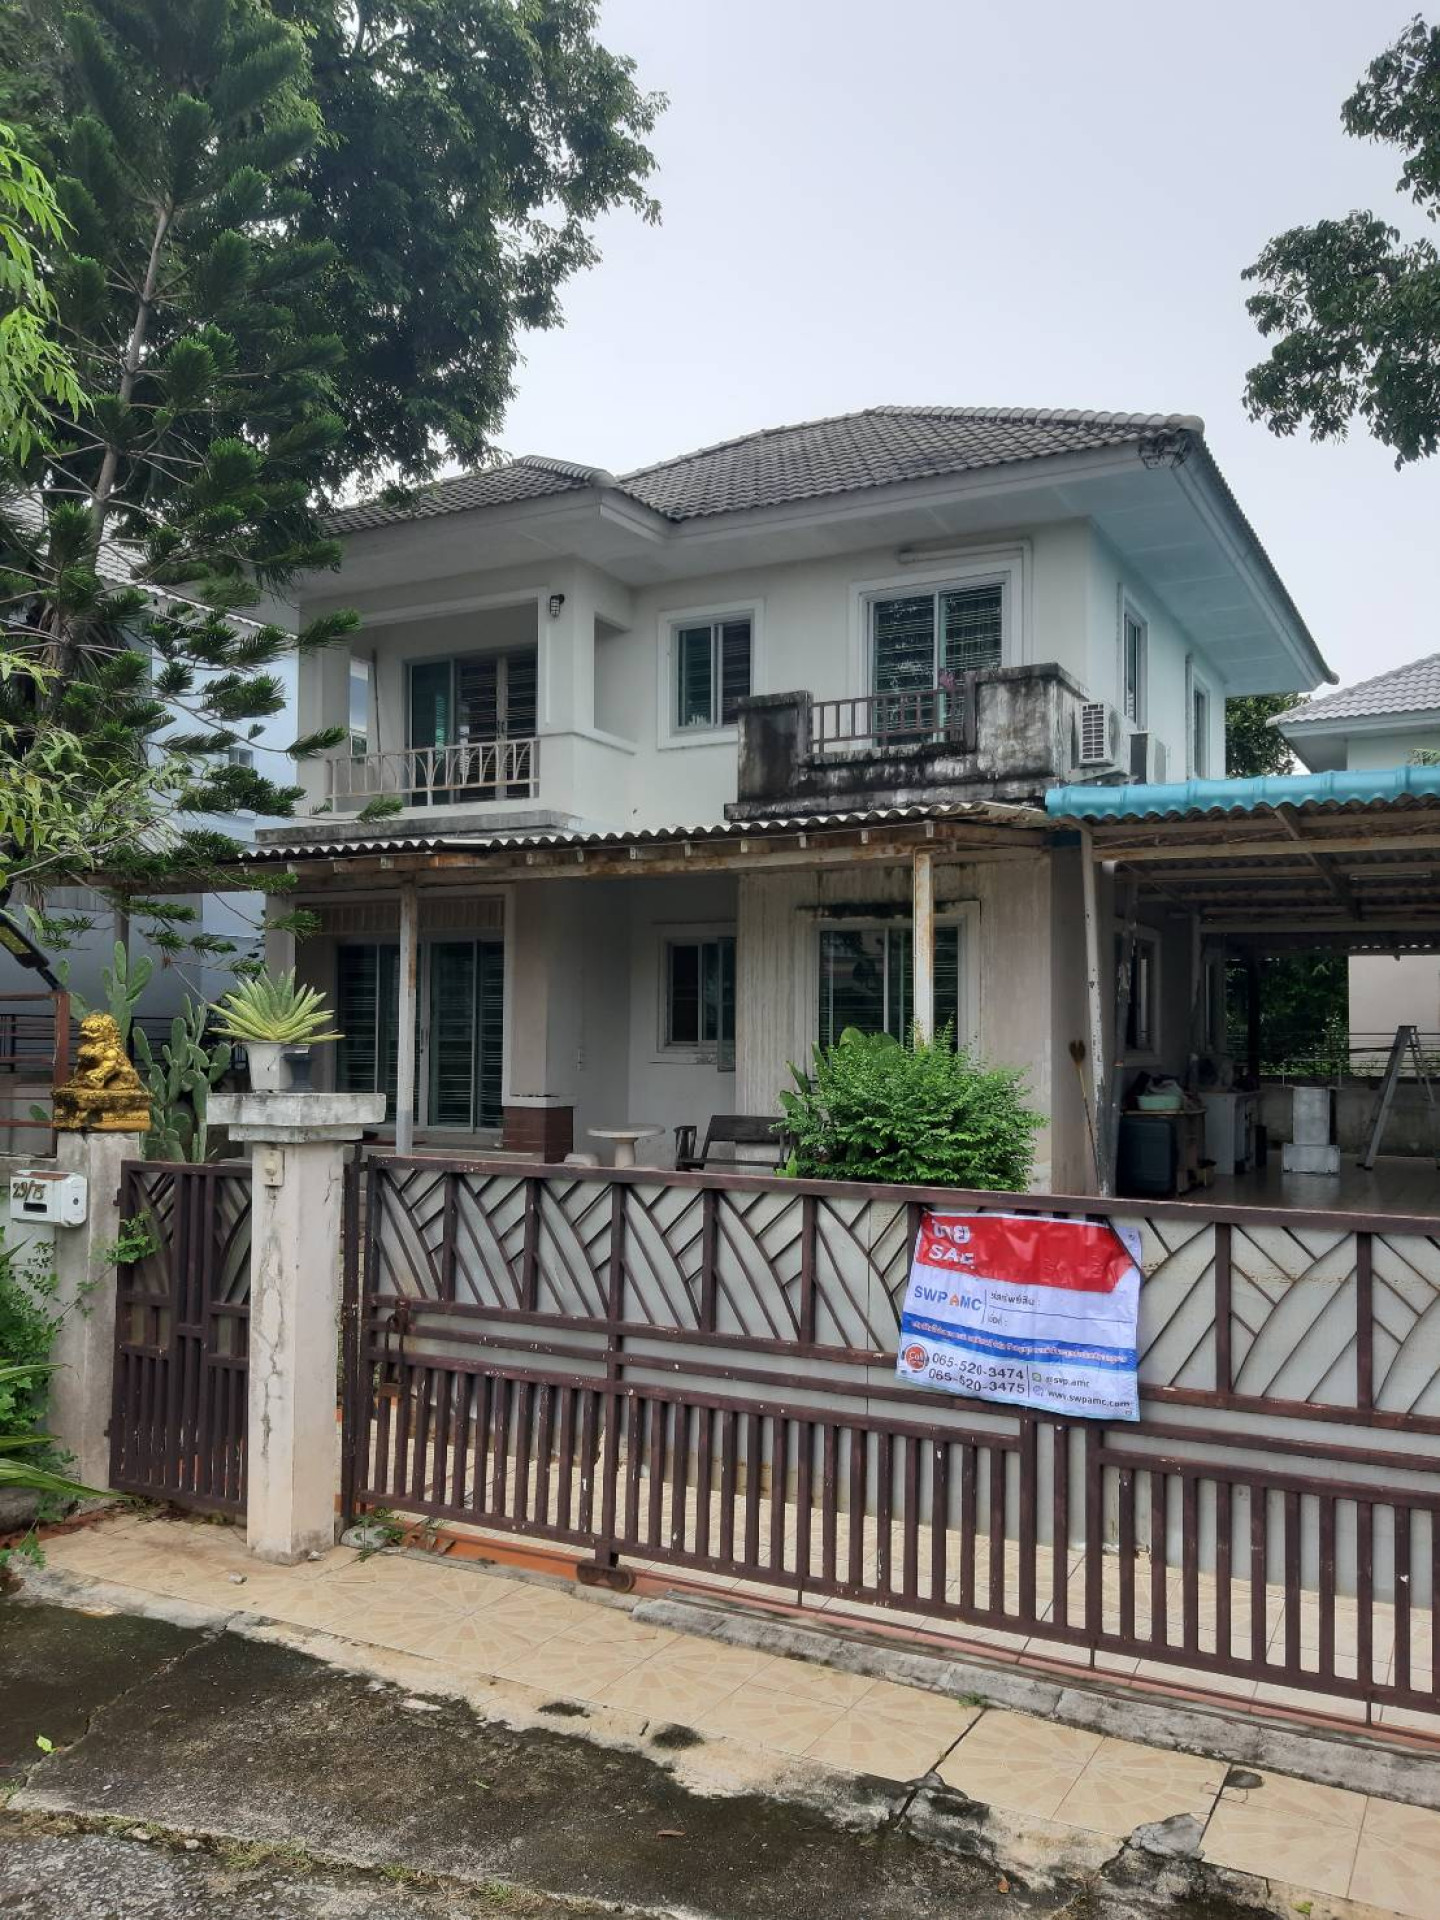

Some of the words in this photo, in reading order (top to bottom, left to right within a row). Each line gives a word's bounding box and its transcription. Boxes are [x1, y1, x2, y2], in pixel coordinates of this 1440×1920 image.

[914, 1285, 948, 1303] SWP
[950, 1293, 982, 1310] AMC
[932, 1353, 1024, 1379] 065-520-3474
[929, 1369, 1025, 1393] 065-520-3475
